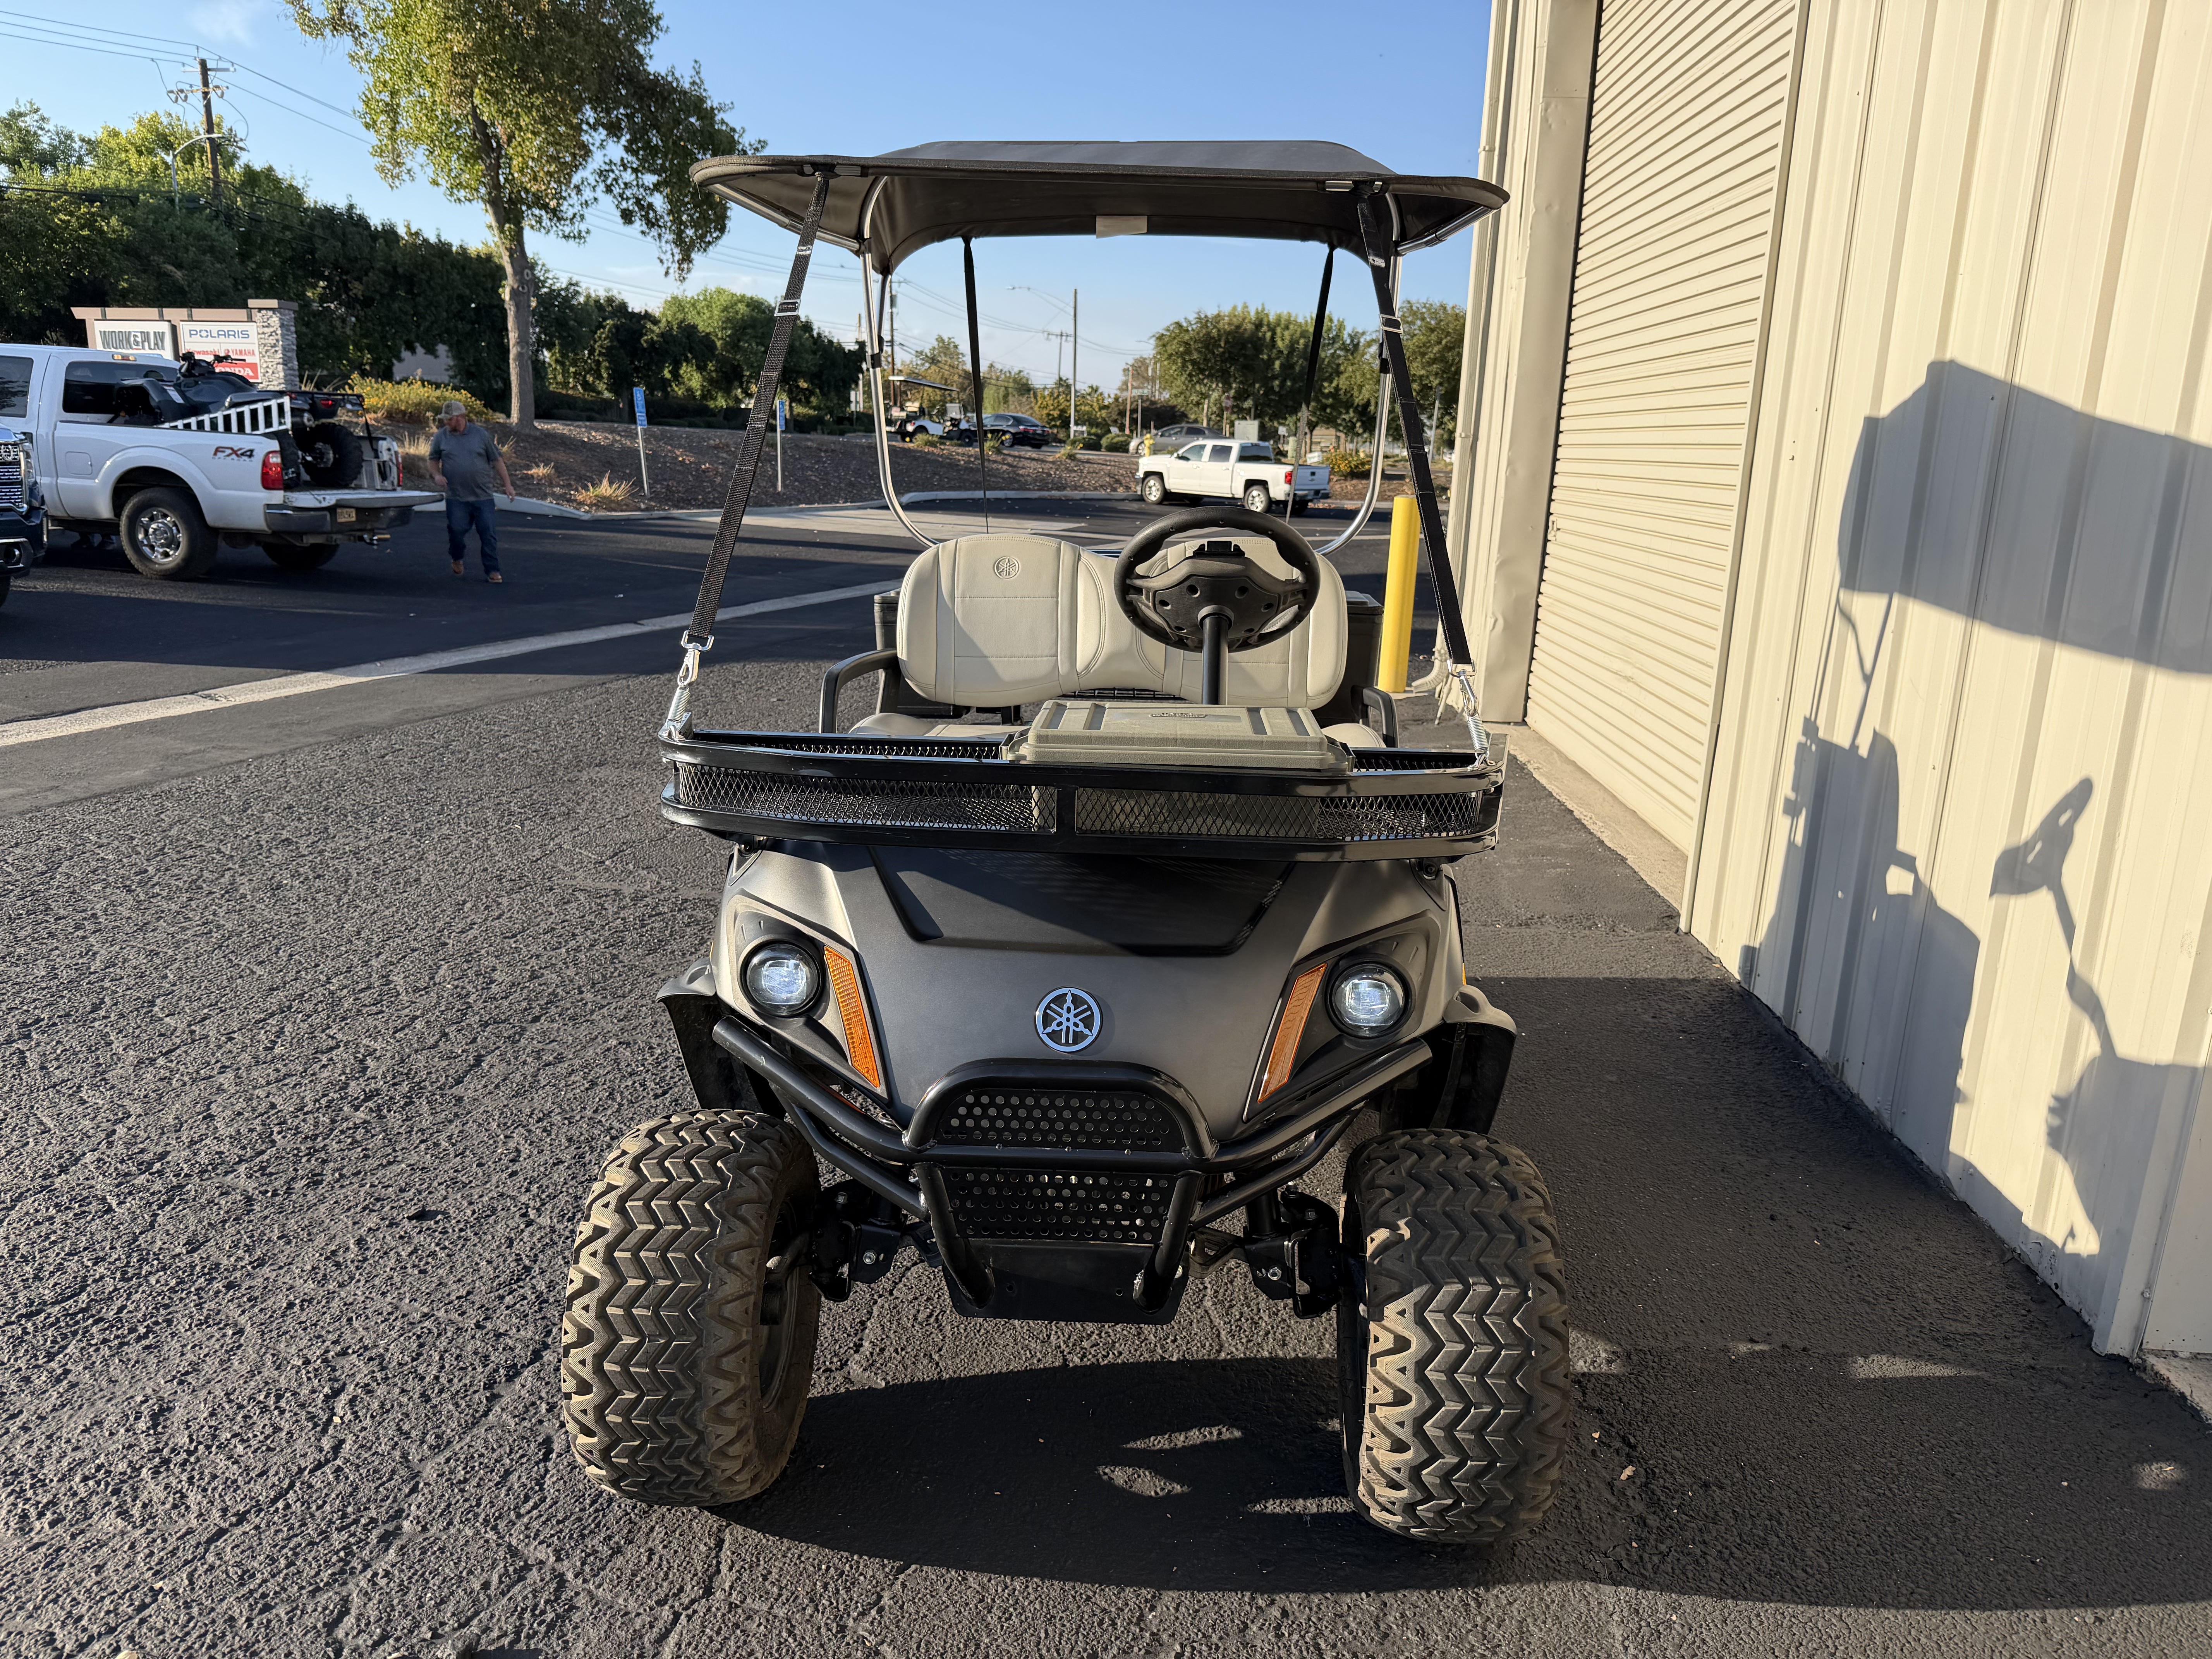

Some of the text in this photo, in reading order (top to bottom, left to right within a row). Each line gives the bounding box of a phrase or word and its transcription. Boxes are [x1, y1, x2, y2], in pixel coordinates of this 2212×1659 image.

[189, 329, 250, 339] POLARIS
[215, 367, 254, 376] ONDA
[213, 446, 255, 459] FX4
